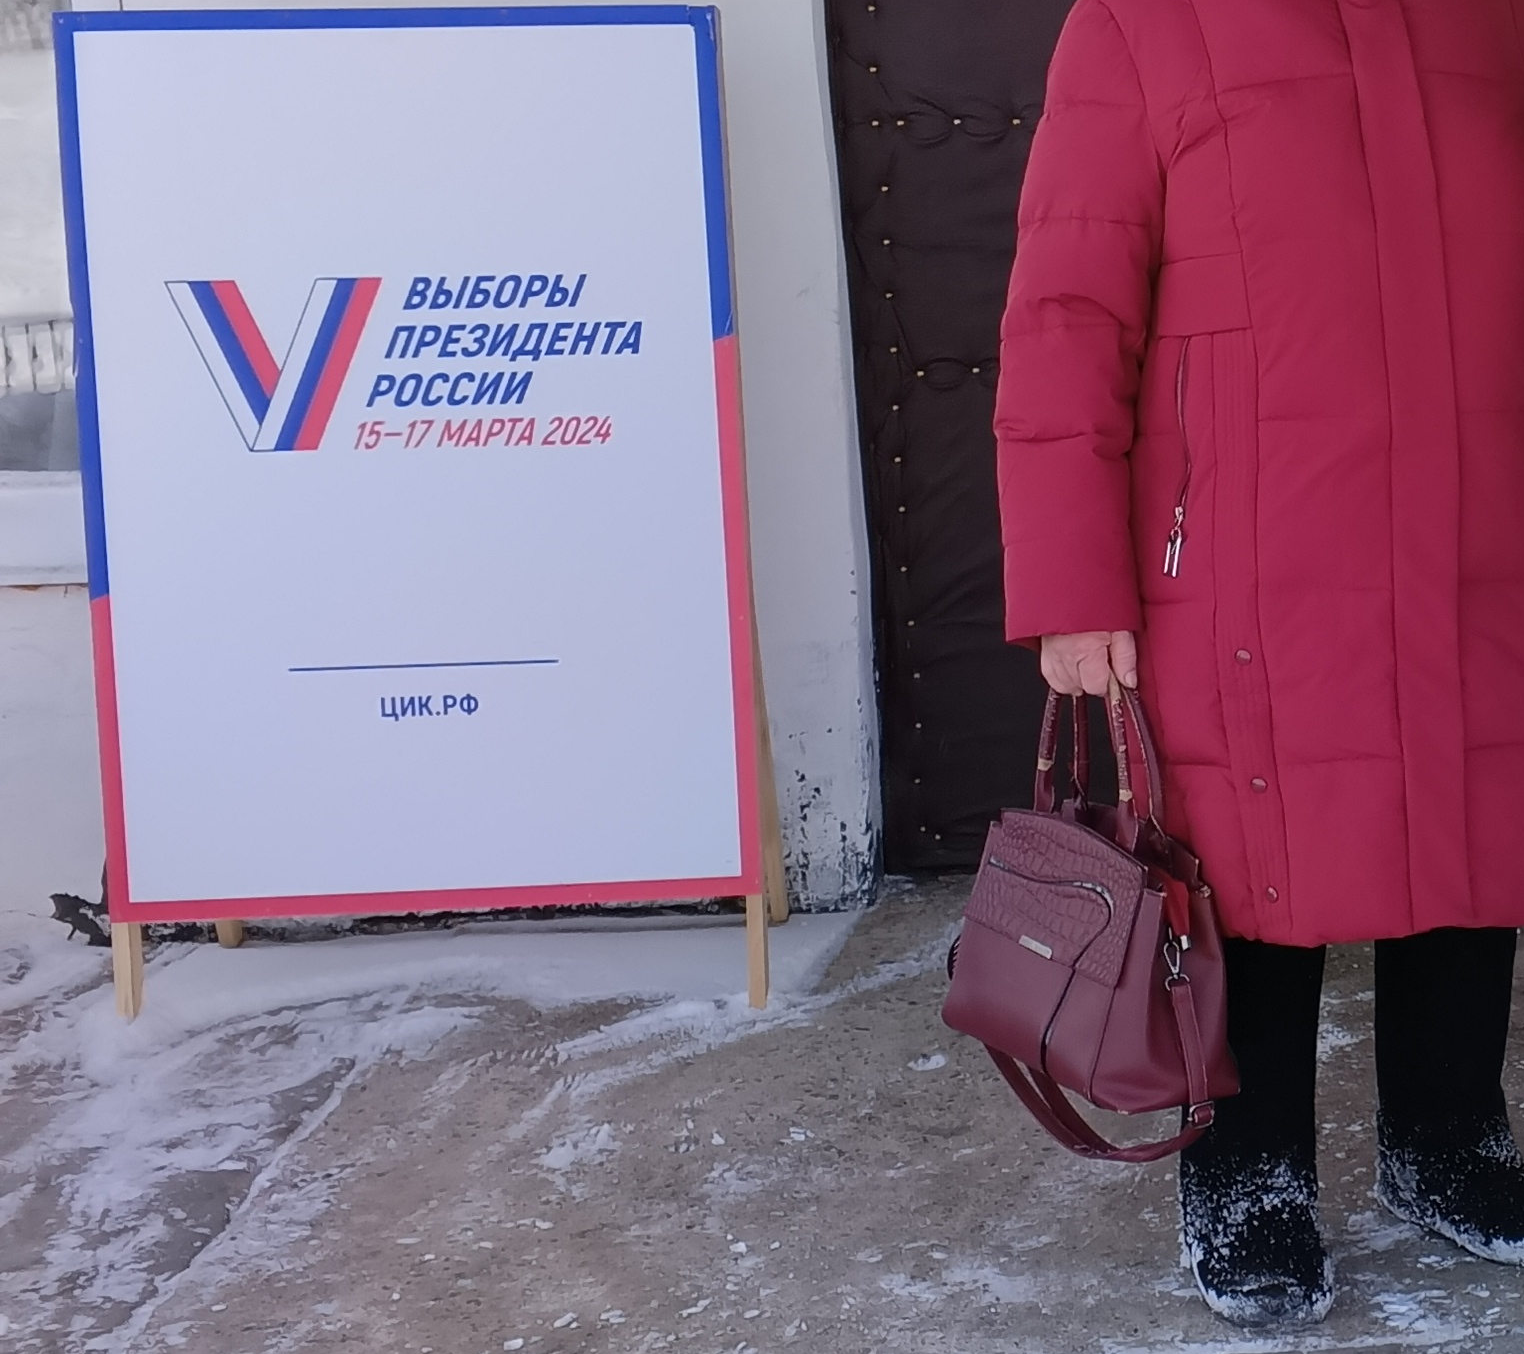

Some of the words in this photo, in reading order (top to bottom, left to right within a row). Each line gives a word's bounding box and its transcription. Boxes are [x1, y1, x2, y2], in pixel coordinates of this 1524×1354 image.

[403, 274, 587, 310] ВЫБОРЫ
[384, 321, 643, 362] ПРЕЗИДЕНТА
[366, 371, 534, 408] РОССИИ
[436, 418, 536, 448] МАРТА
[540, 416, 613, 446] 2024
[380, 694, 480, 721] ЦИК.РФ
